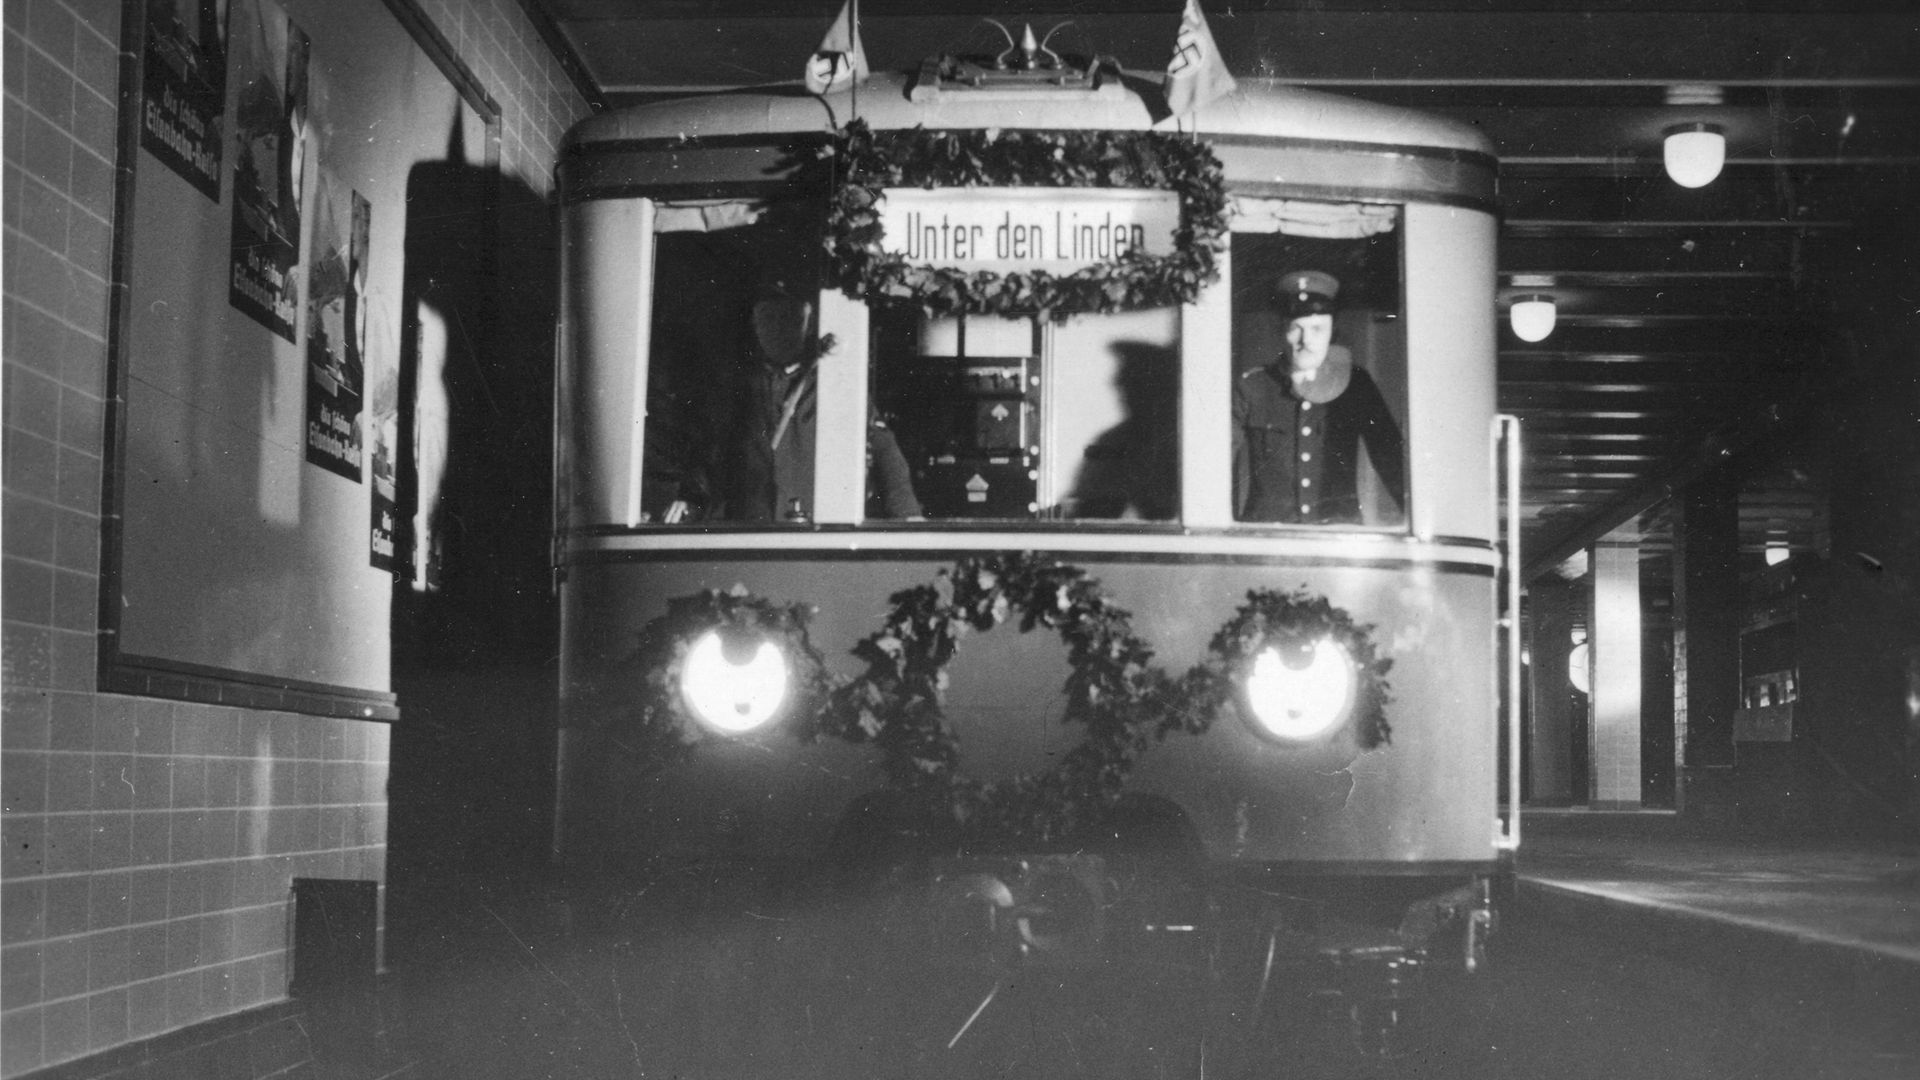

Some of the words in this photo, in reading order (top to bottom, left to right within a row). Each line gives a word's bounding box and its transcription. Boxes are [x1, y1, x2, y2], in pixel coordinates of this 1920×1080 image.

[907, 211, 982, 259] Unter
[996, 211, 1043, 259] den
[1056, 211, 1144, 259] Linden
